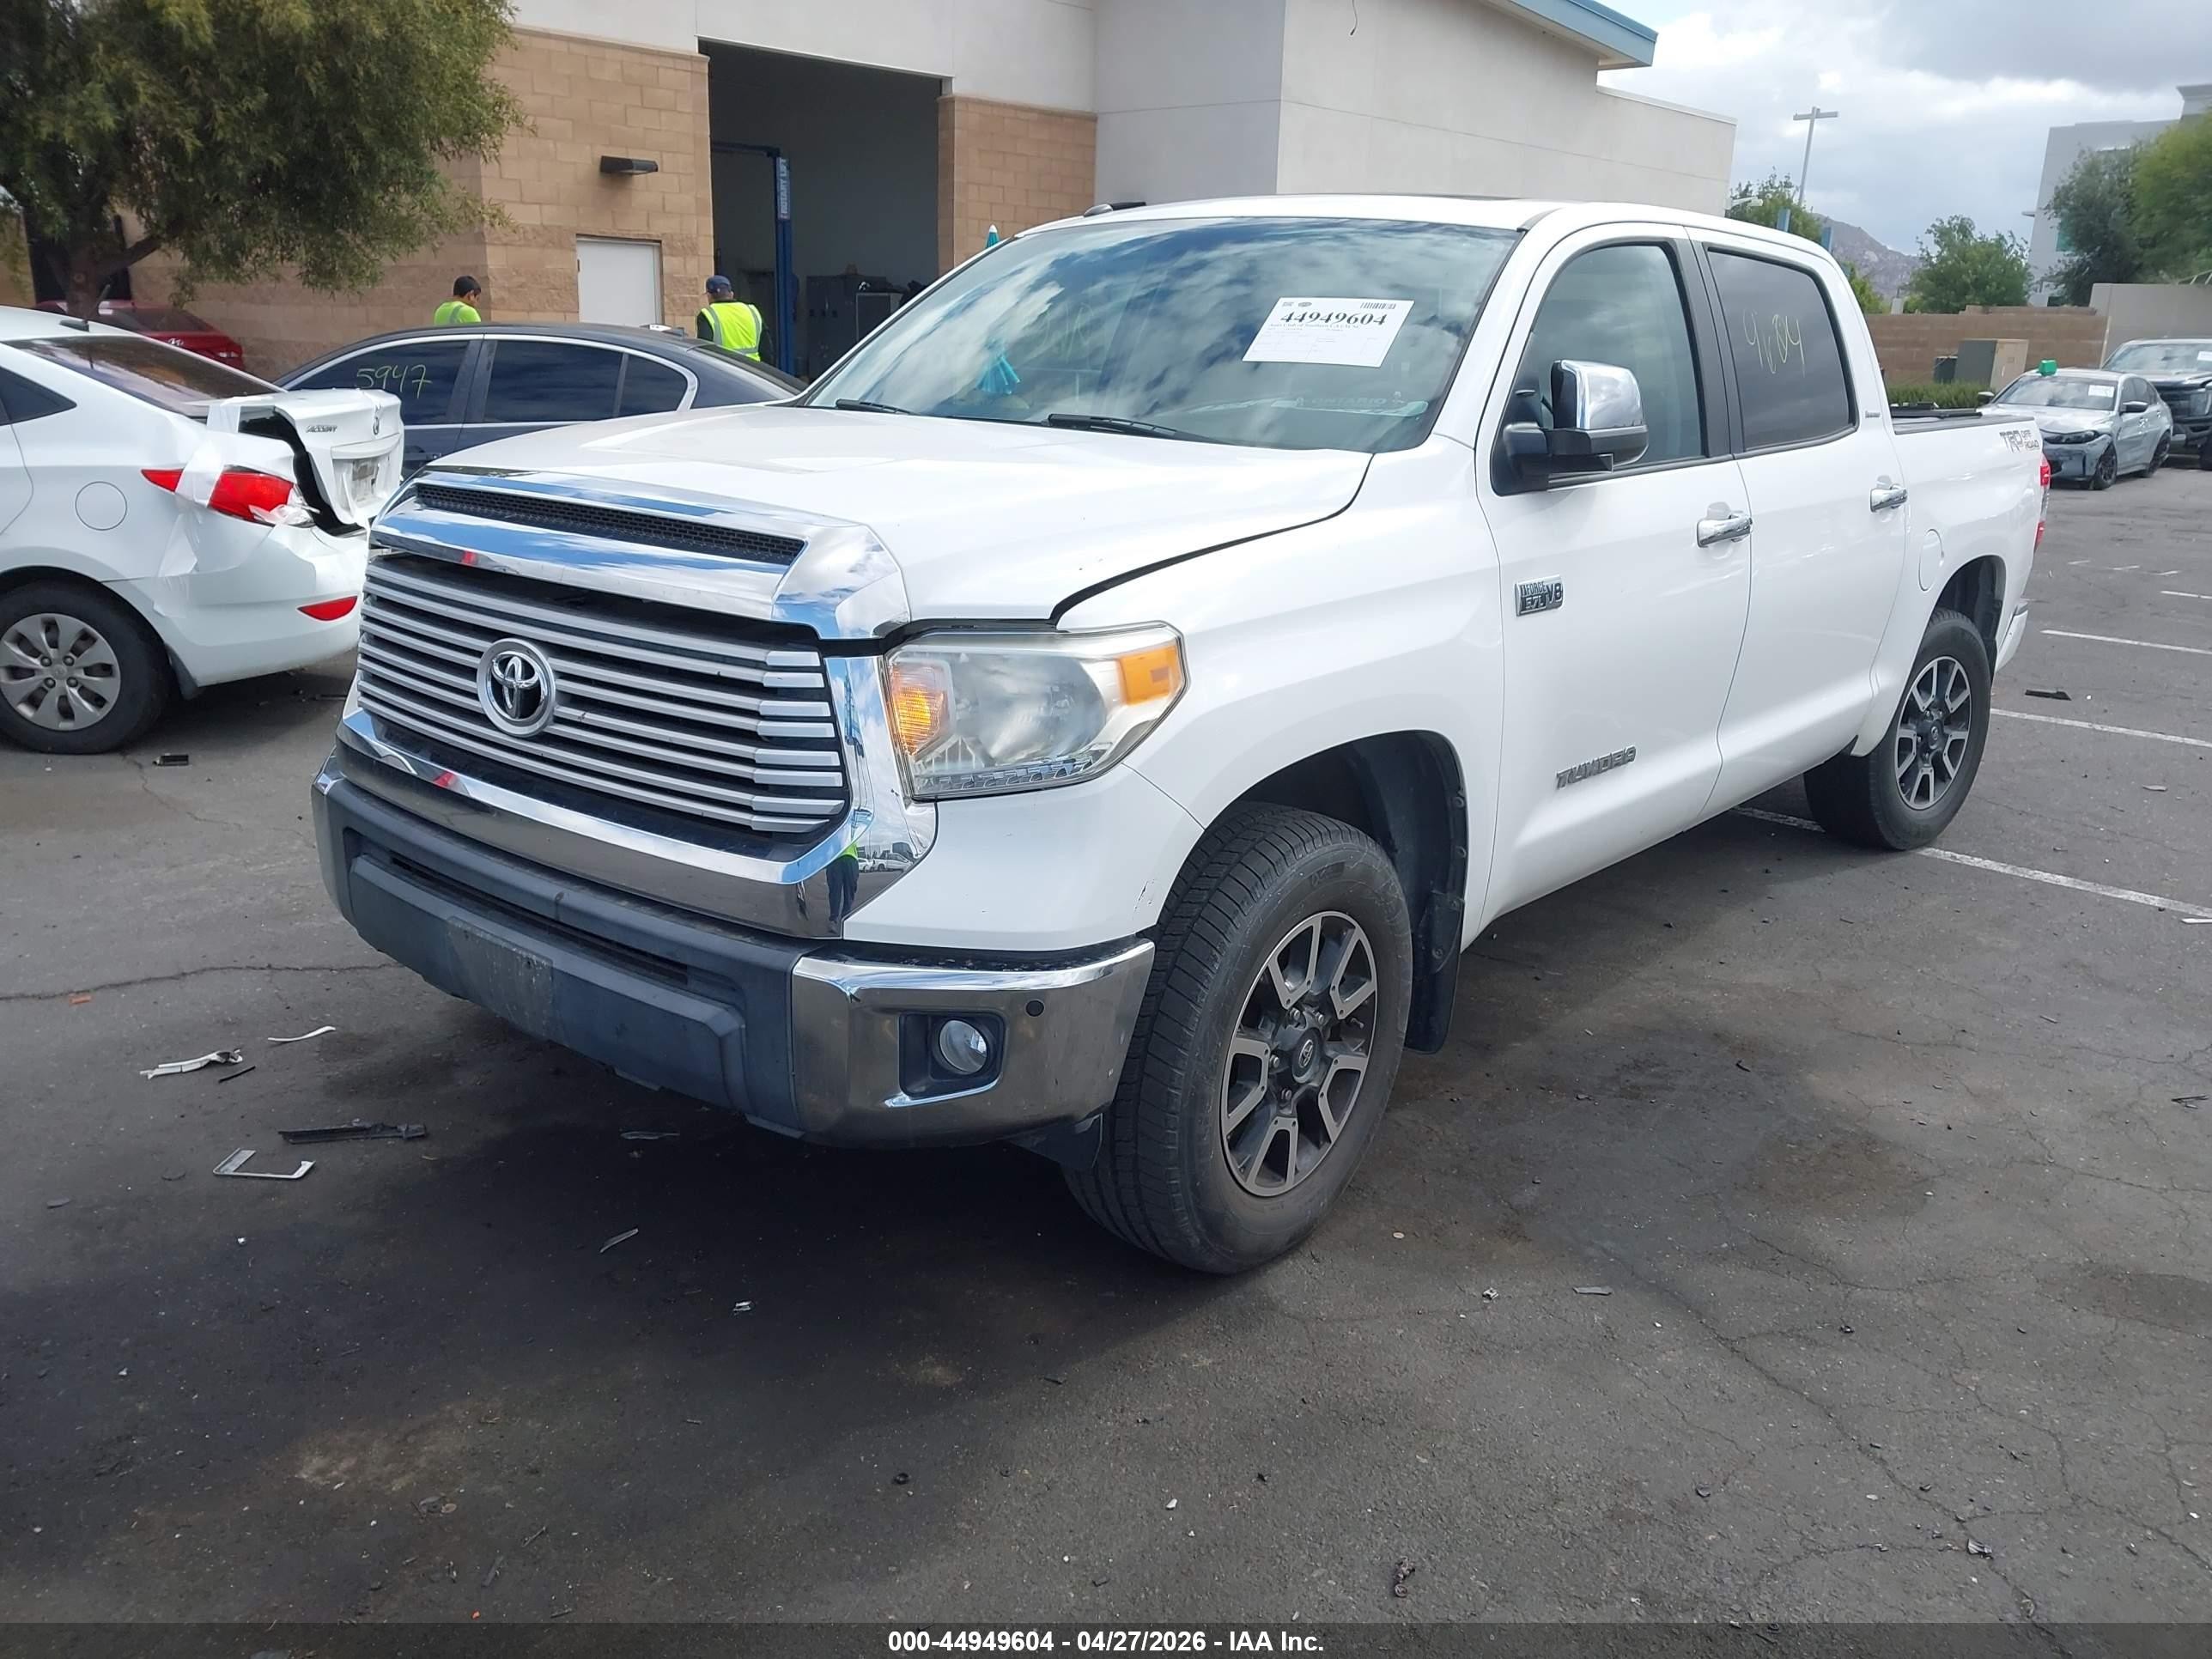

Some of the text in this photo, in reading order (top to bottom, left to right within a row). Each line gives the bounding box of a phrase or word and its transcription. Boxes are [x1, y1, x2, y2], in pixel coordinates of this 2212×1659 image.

[1280, 311, 1388, 325] 44949604
[356, 364, 432, 398] 5947
[1999, 430, 2023, 453] TRD
[1547, 583, 1562, 601] V8
[1557, 744, 1637, 788] TUNDRA
